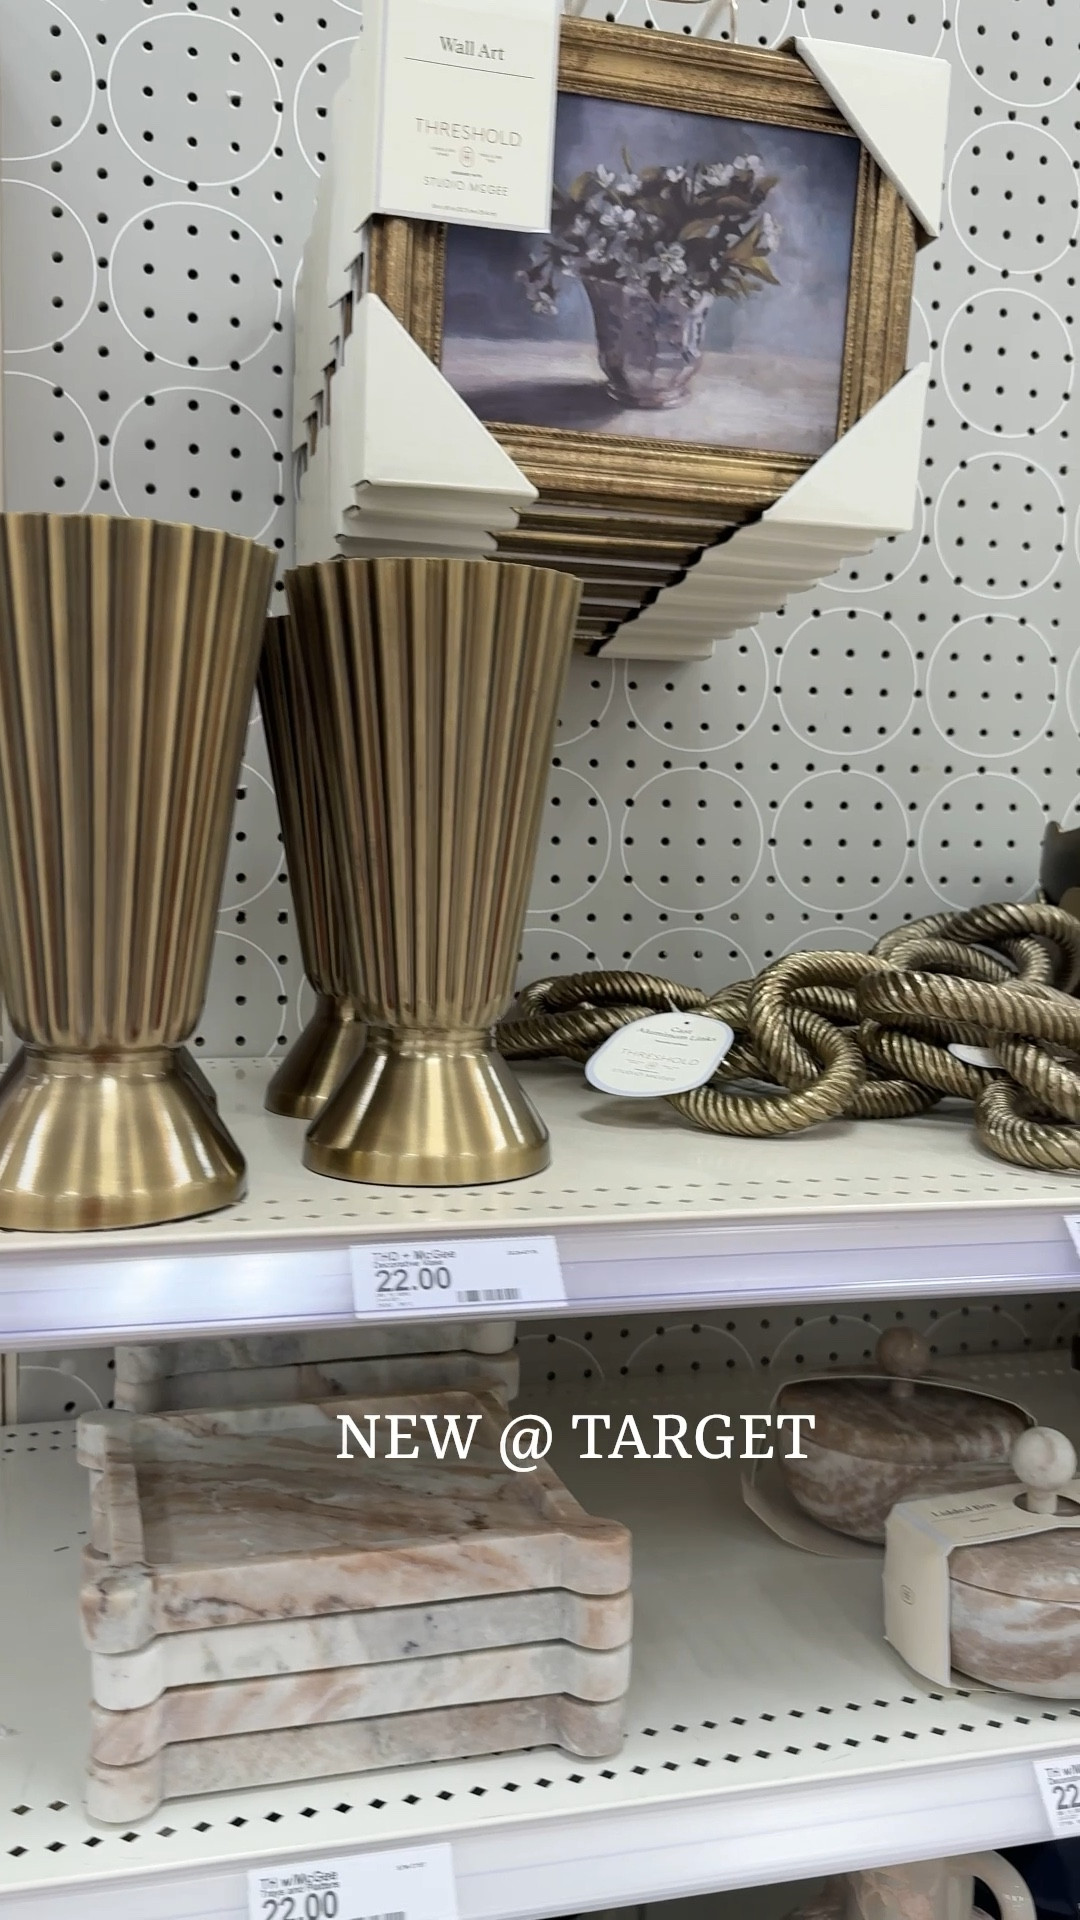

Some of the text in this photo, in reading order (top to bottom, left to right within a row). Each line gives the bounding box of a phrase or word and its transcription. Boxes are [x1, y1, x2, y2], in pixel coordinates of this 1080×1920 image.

[440, 36, 504, 60] Wall Art
[416, 117, 522, 147] THRESHOLD
[423, 176, 465, 191] STUDIO
[622, 1048, 700, 1065] THRESHOLD
[413, 1249, 457, 1260] McGee
[375, 1267, 451, 1292] 22.00
[931, 1505, 972, 1516] Lidded
[281, 1871, 338, 1887] w/McGee
[262, 1891, 337, 1920] 22.00
